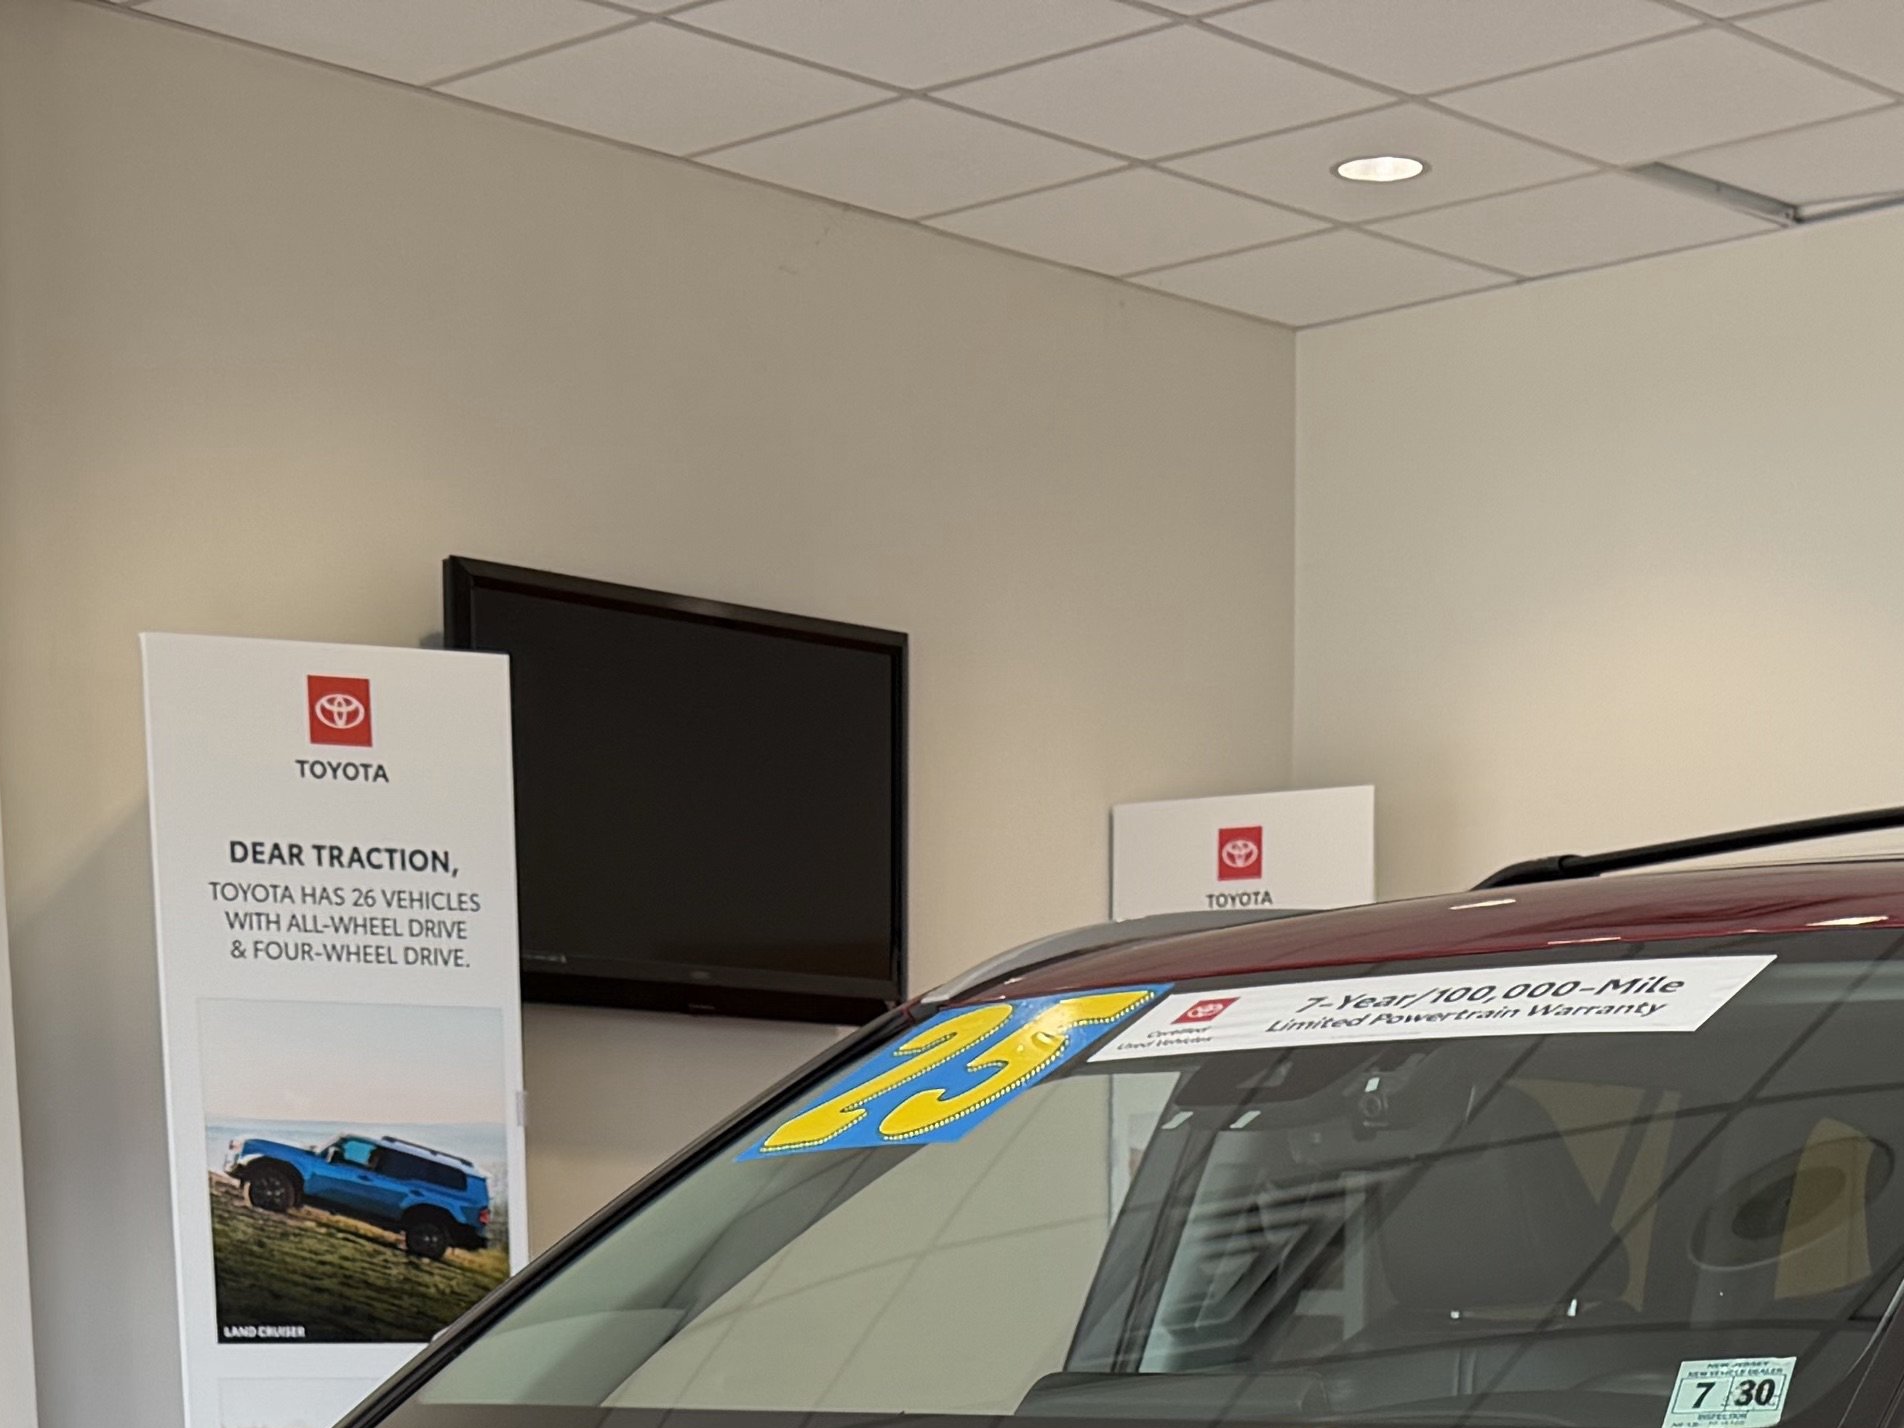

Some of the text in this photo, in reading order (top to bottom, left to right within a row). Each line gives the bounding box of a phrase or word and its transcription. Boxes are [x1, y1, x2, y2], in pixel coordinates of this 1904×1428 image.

[295, 759, 389, 783] TOYOTA
[229, 840, 459, 878] DEAR TRACTION,
[208, 881, 481, 913] TOYOTA HAS 26 VEHICLES
[1205, 890, 1273, 910] TOYOTA
[224, 911, 468, 940] WITH ALL-WHEEL DRIVE
[230, 939, 470, 968] & FOUR-WHEEL DRIVE.
[1296, 976, 1685, 1012] 7-Year/100,000-Mile
[1265, 1000, 1667, 1032] Limited Powertrain Warranty
[1691, 1378, 1776, 1409] 7 30
